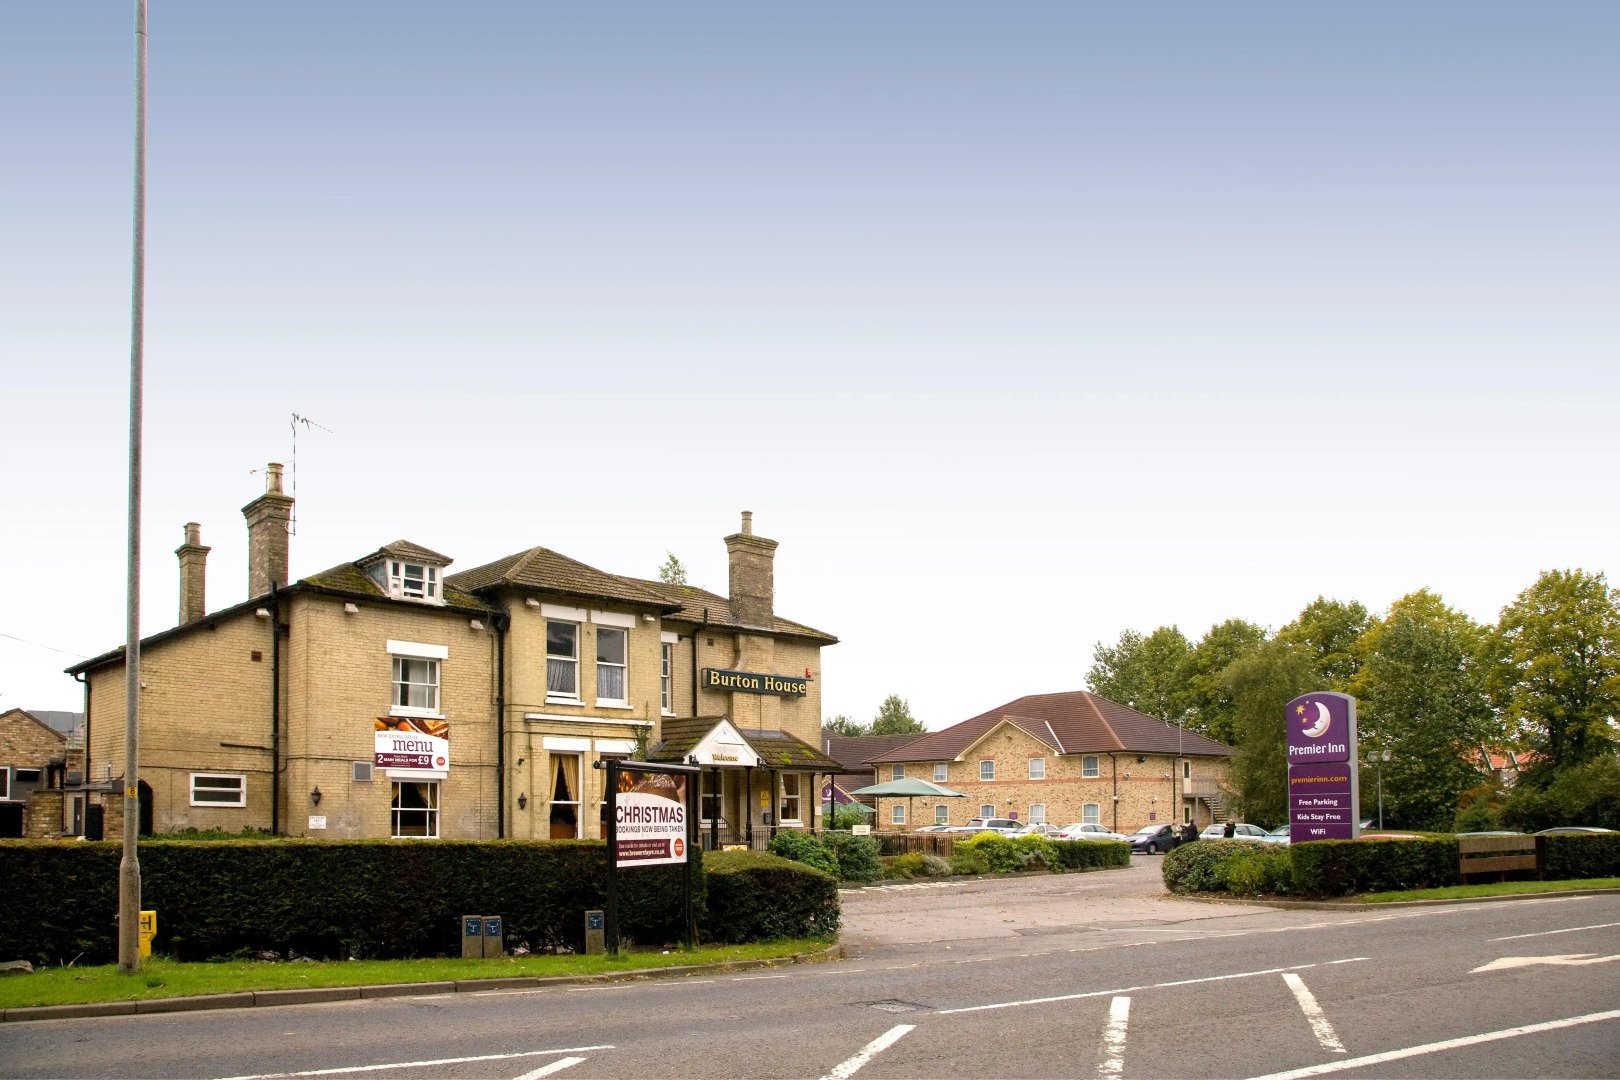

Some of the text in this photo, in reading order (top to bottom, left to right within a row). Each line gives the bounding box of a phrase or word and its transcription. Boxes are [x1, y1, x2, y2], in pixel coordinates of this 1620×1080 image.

[710, 671, 805, 693] Burton House
[393, 740, 433, 752] menu
[1289, 743, 1345, 755] Premier Inn
[378, 754, 383, 763] 2
[418, 756, 429, 764] £9
[712, 754, 738, 762] Welcome
[1291, 776, 1347, 785] premierinn.com
[616, 806, 683, 823] CHRISTMAS
